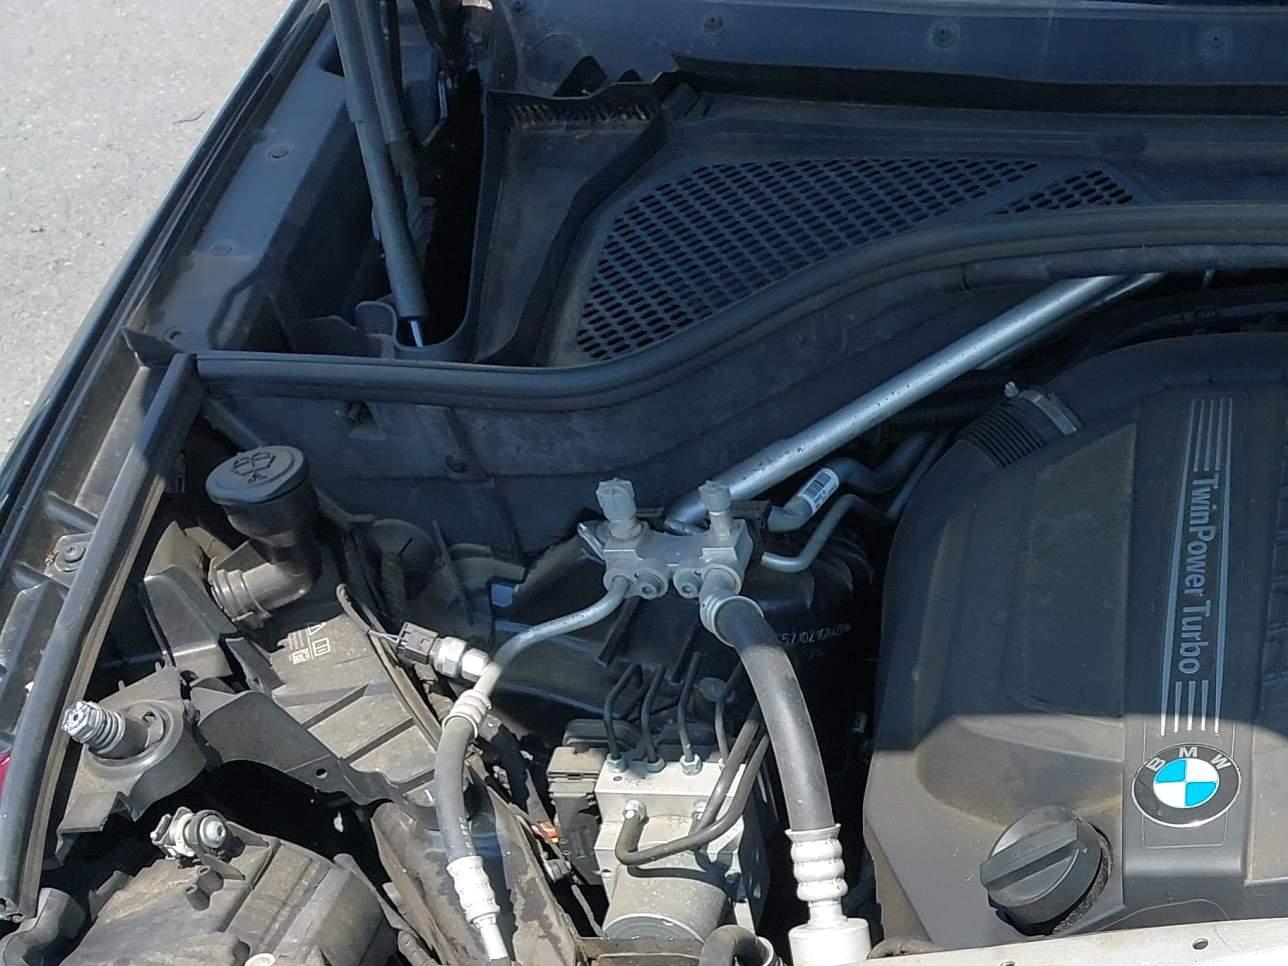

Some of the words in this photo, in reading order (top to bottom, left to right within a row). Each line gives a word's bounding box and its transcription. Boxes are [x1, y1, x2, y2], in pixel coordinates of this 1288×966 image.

[1184, 472, 1220, 598] TwinPower
[1178, 599, 1212, 675] Turbo
[1145, 746, 1232, 772] BMW
